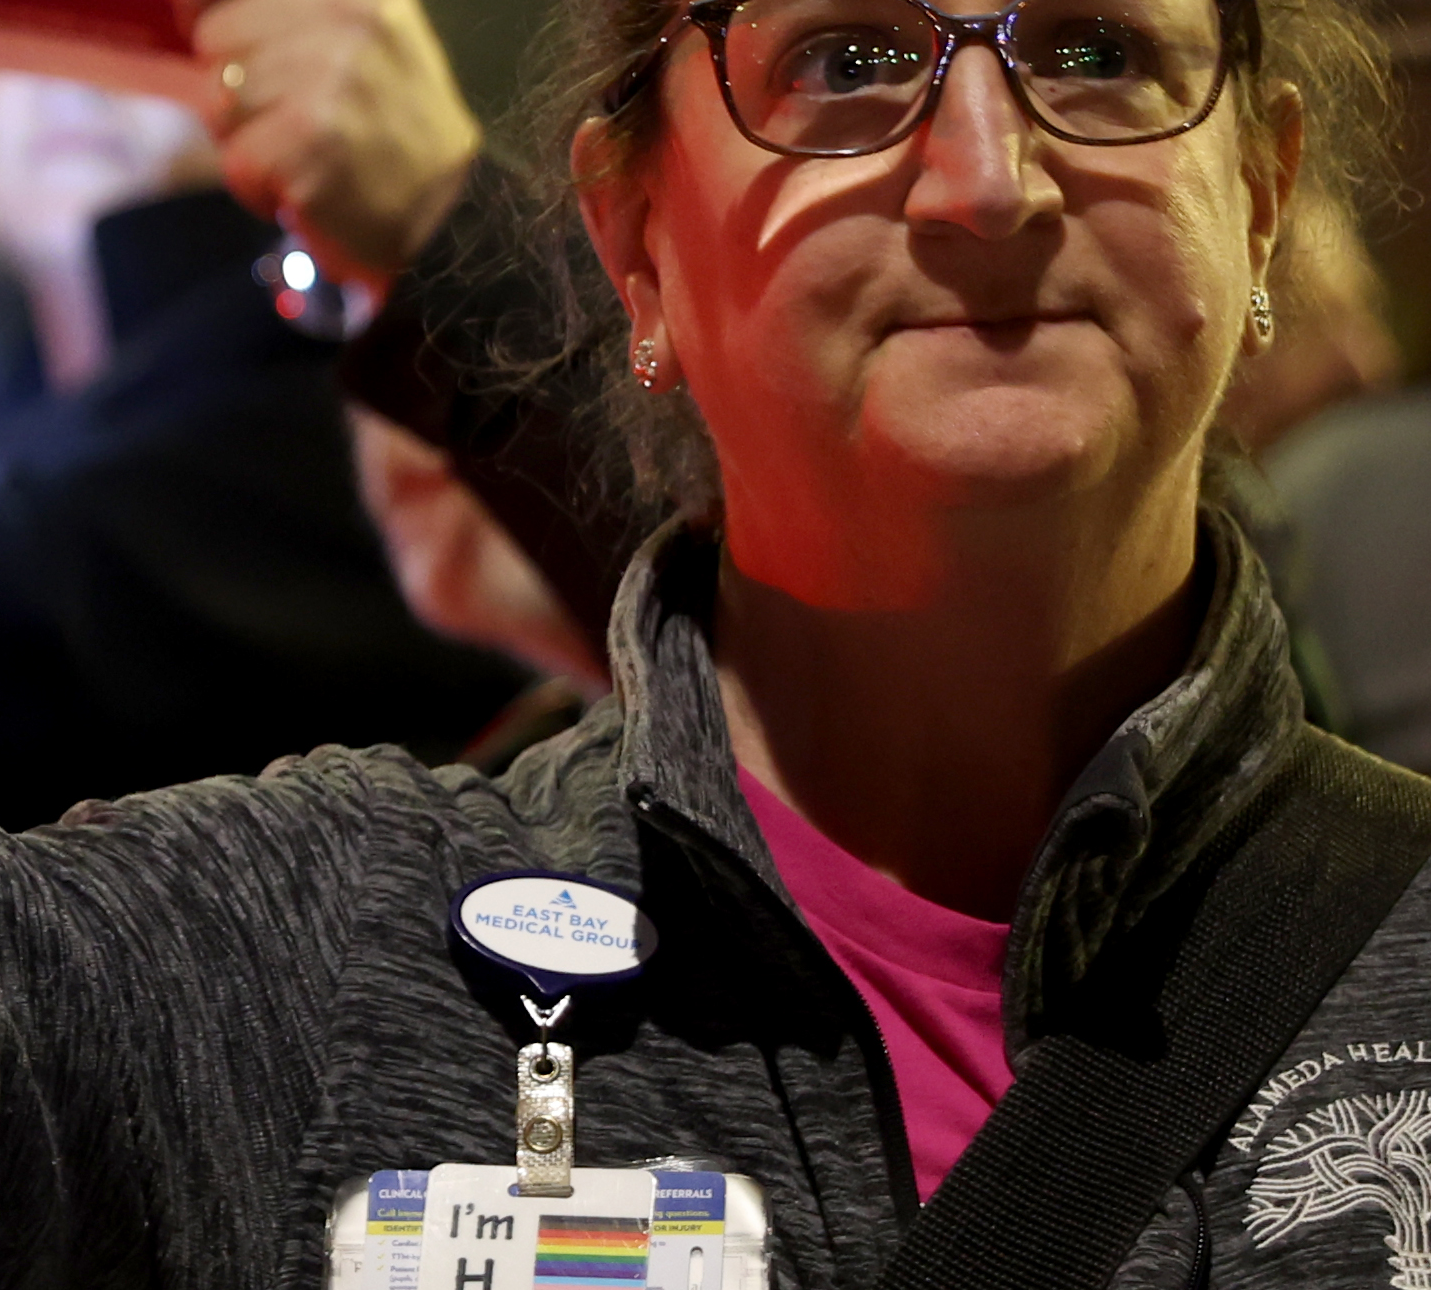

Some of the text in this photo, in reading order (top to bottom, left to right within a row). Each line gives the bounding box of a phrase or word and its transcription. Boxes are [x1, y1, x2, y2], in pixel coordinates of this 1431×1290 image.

[475, 913, 565, 939] MEDICAL
[512, 904, 608, 930] EAST BAY
[1228, 1051, 1345, 1153] ALAMEDA
[378, 1189, 424, 1200] CLINICAL
[655, 1188, 713, 1199] REFERRALS
[449, 1203, 515, 1240] I'm
